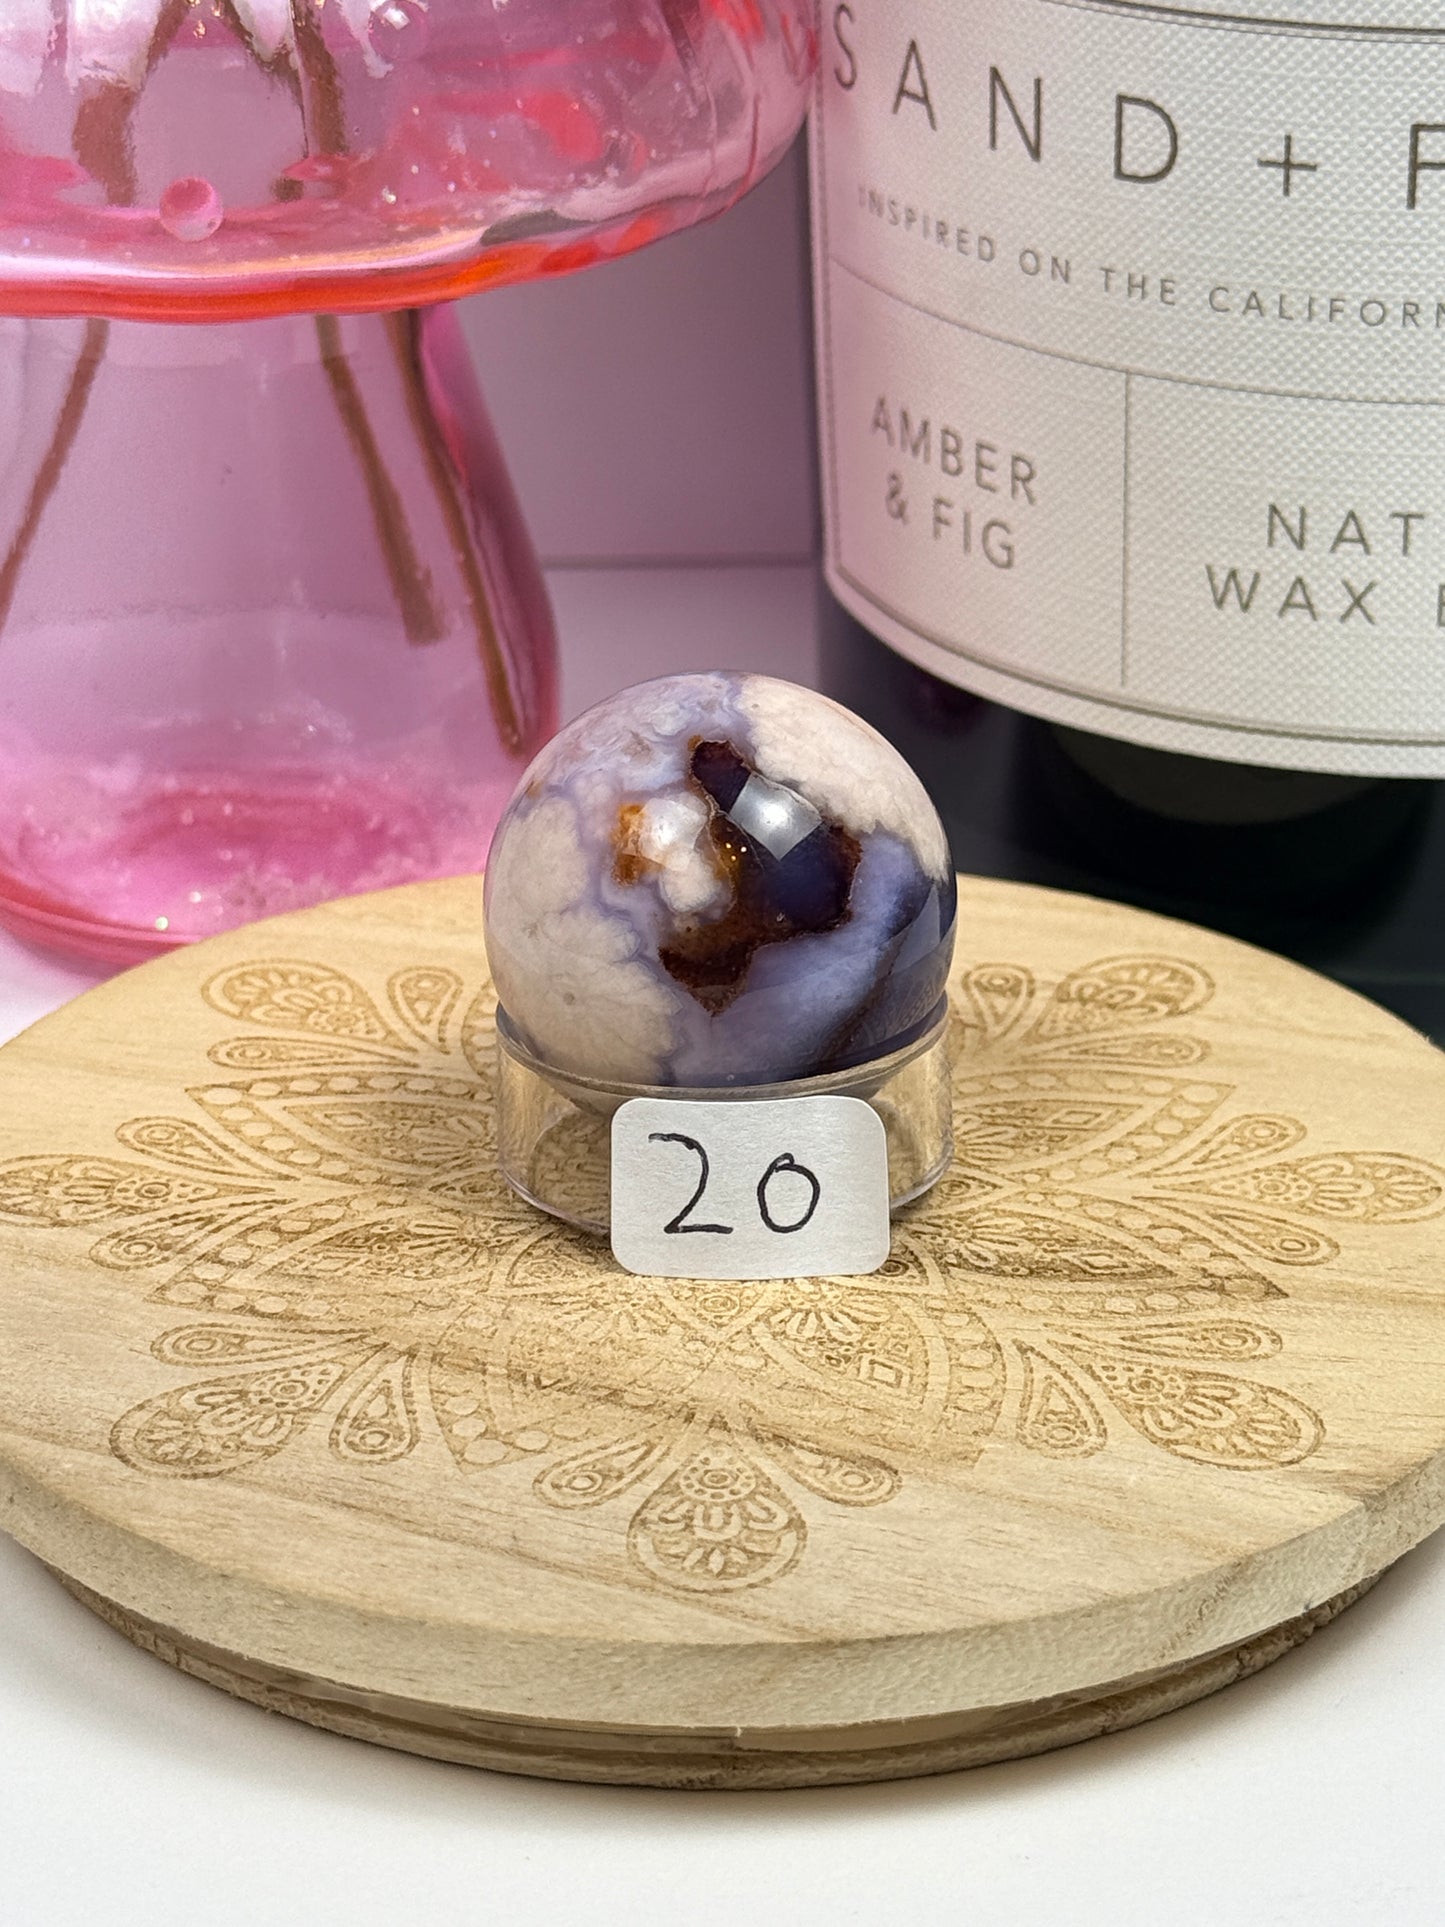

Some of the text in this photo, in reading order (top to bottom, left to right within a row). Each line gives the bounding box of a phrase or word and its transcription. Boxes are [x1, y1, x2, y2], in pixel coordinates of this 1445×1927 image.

[833, 4, 1178, 184] SAND
[858, 185, 996, 262] INSPIRED
[1018, 249, 1072, 283] ON
[1100, 268, 1177, 306] THE
[872, 396, 1037, 506] AMBER
[886, 472, 1016, 569] & FIG
[1266, 503, 1425, 556] NAT
[1205, 564, 1377, 626] WAX
[648, 1132, 821, 1234] 20
